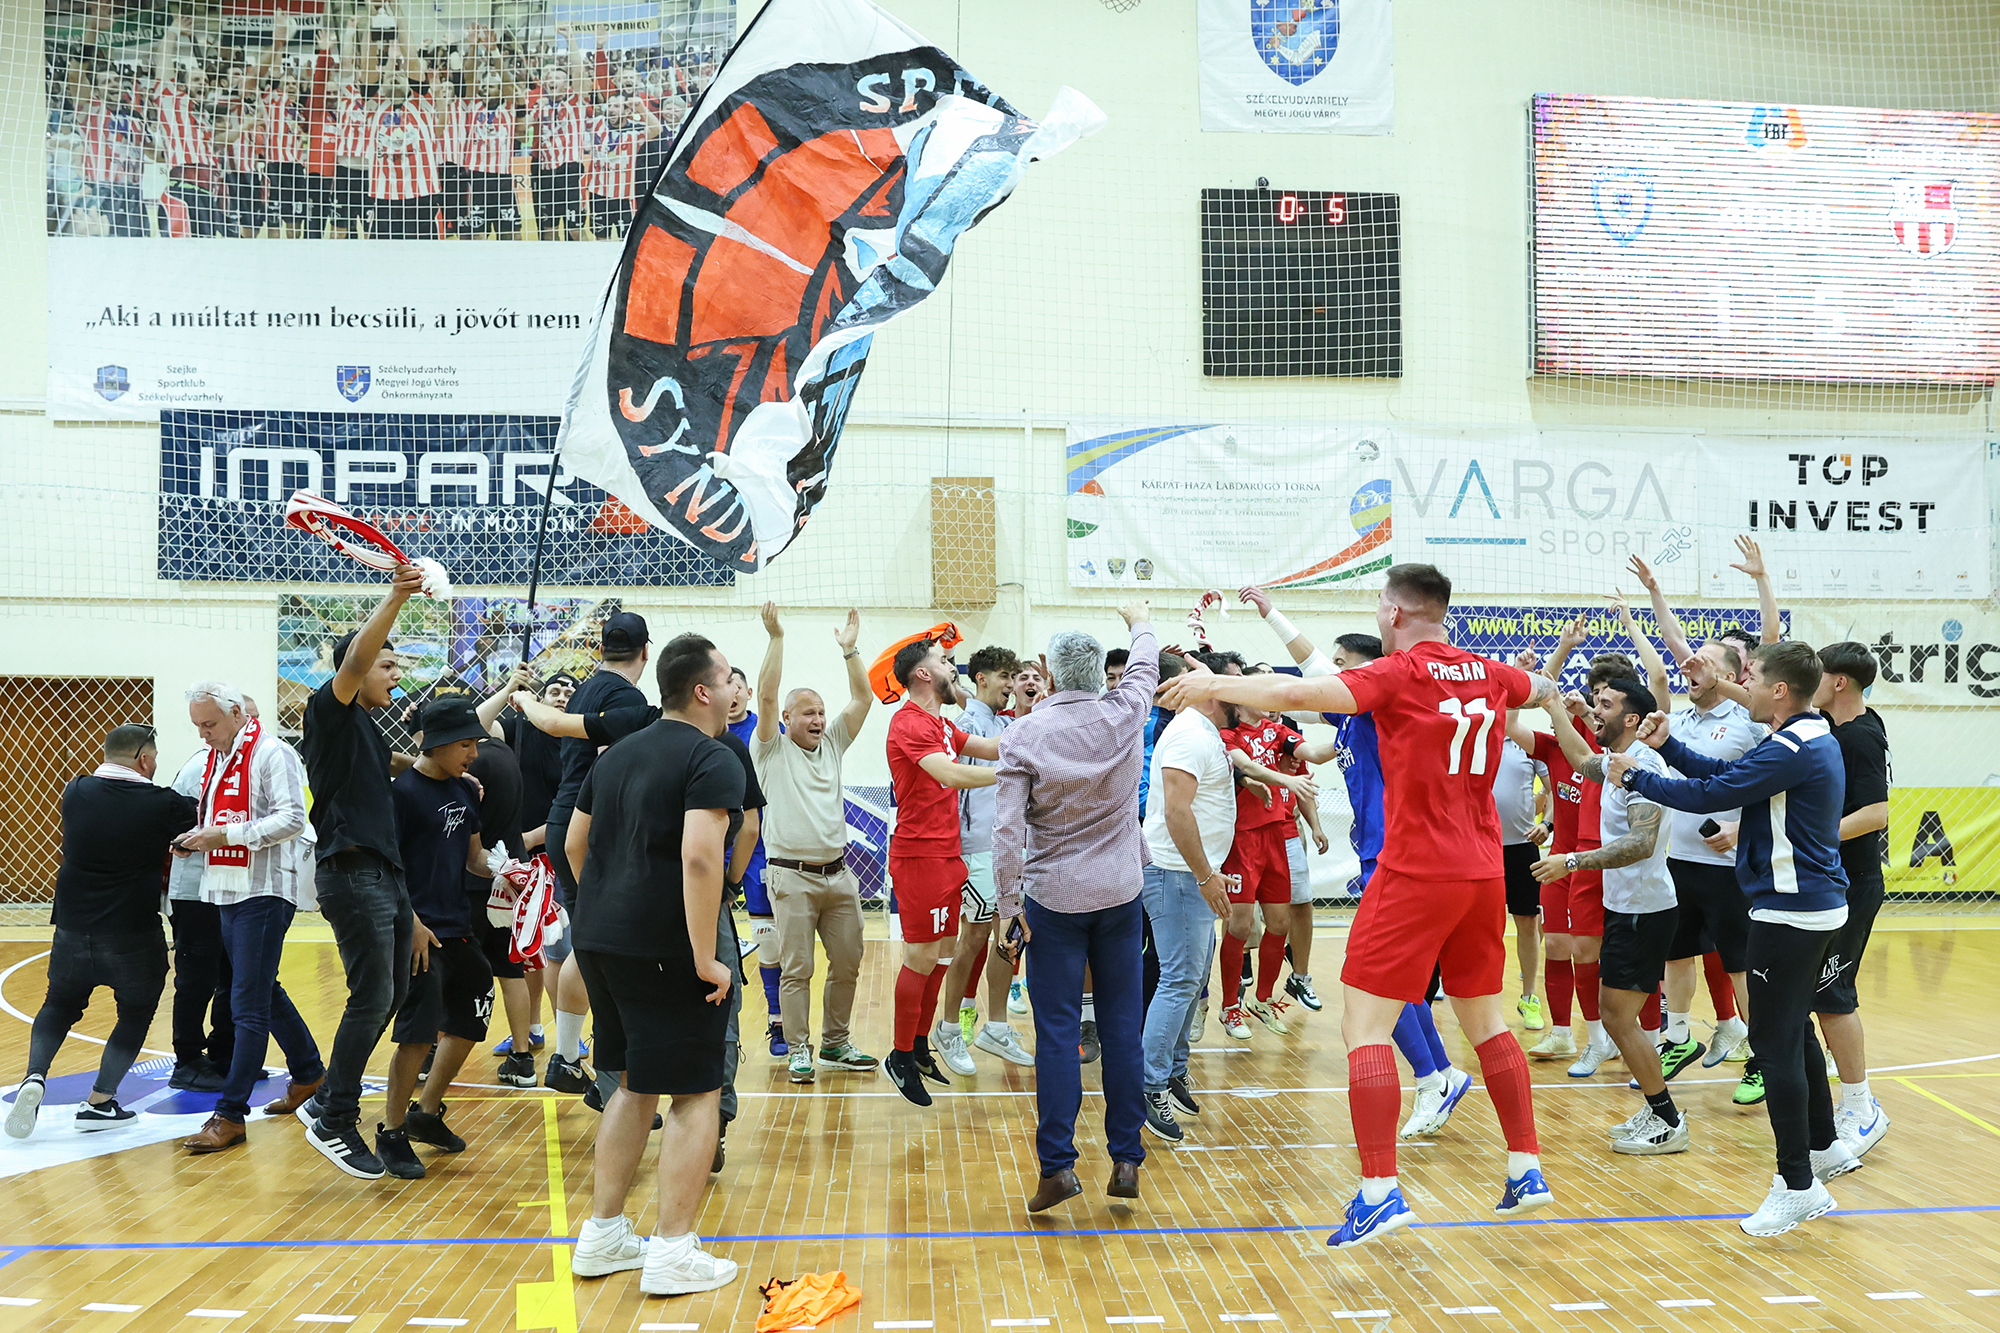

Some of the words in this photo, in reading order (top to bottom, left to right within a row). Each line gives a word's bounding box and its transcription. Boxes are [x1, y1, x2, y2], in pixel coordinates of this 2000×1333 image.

[1246, 93, 1349, 106] SZÉKELYUDVARHELY
[1254, 109, 1287, 118] MEGYEI
[1289, 109, 1311, 119] JOGÚ
[1313, 109, 1341, 119] VÁROS
[1280, 196, 1297, 221] 0
[1328, 197, 1344, 223] 5
[149, 311, 162, 327] a
[171, 305, 259, 328] múltat
[267, 312, 321, 328] nem
[330, 306, 425, 332] becsüli,
[434, 313, 447, 328] a
[450, 307, 520, 336] jövőt
[527, 314, 580, 329] nem
[166, 364, 198, 375] Szejke
[378, 364, 457, 375] Székelyudvarhely
[157, 378, 206, 389] Sportklub
[375, 377, 409, 388] Megyei
[411, 377, 432, 388] Jogú
[434, 377, 459, 387] Város
[138, 391, 224, 403] Székelyudvarhely
[381, 390, 453, 400] Önkormányzata
[201, 446, 576, 506] IMPAR
[1788, 453, 1888, 486] TOP
[1395, 458, 1673, 521] VARGA
[451, 516, 471, 532] IN
[485, 516, 575, 533] MOTION
[1749, 500, 1935, 534] INVEST
[1539, 530, 1652, 556] SPORT
